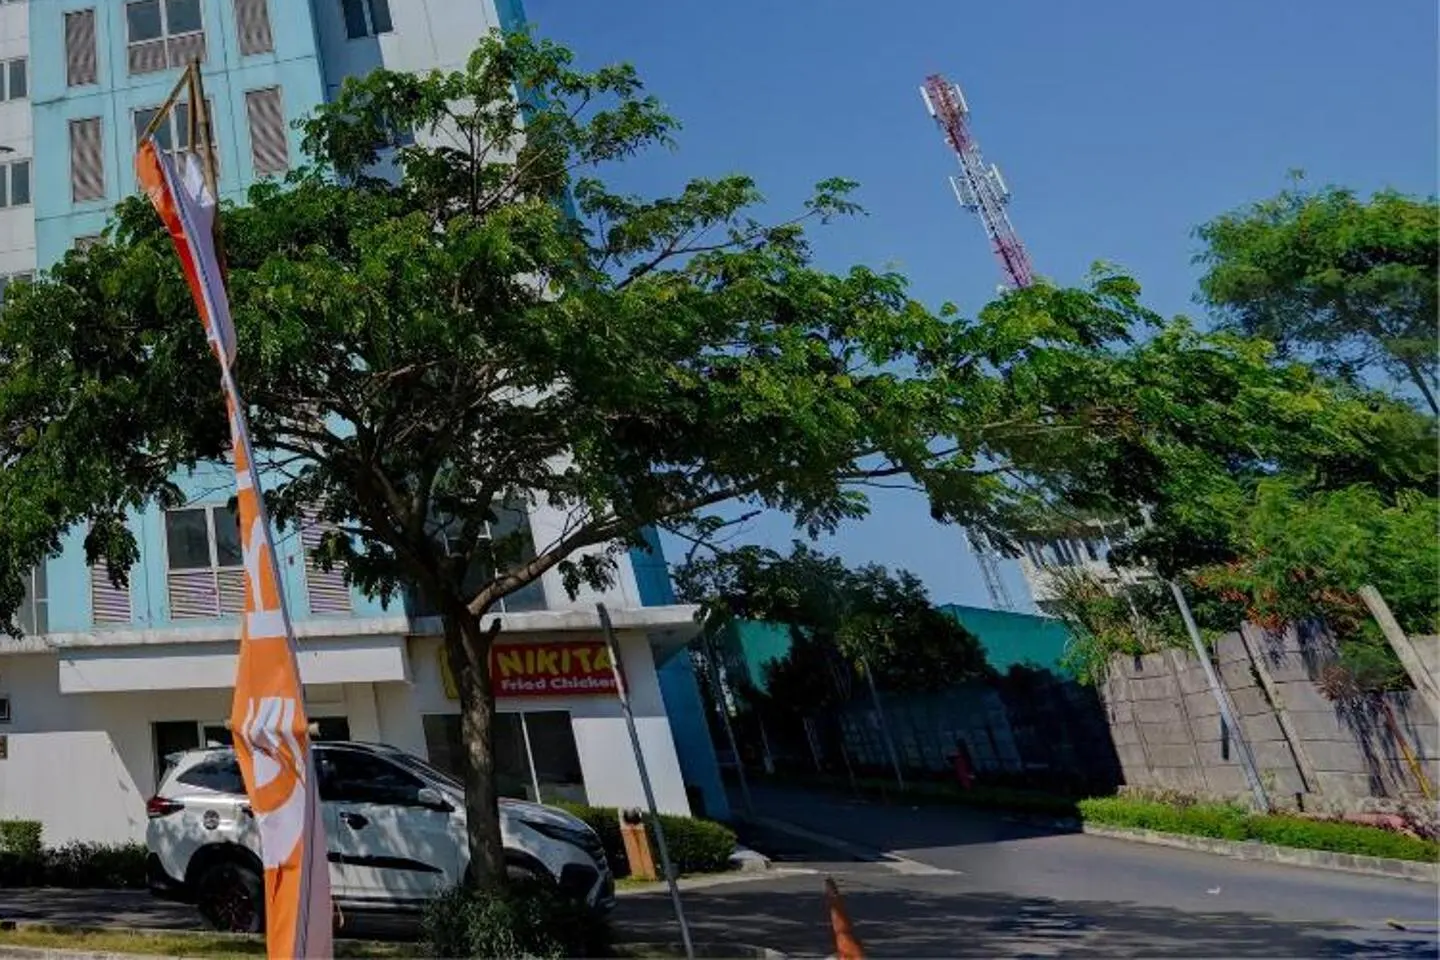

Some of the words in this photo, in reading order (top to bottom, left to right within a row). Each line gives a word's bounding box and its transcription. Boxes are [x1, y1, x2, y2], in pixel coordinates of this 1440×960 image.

[496, 647, 613, 677] NIKITA
[501, 677, 546, 691] Fried
[550, 675, 617, 689] Chicken
